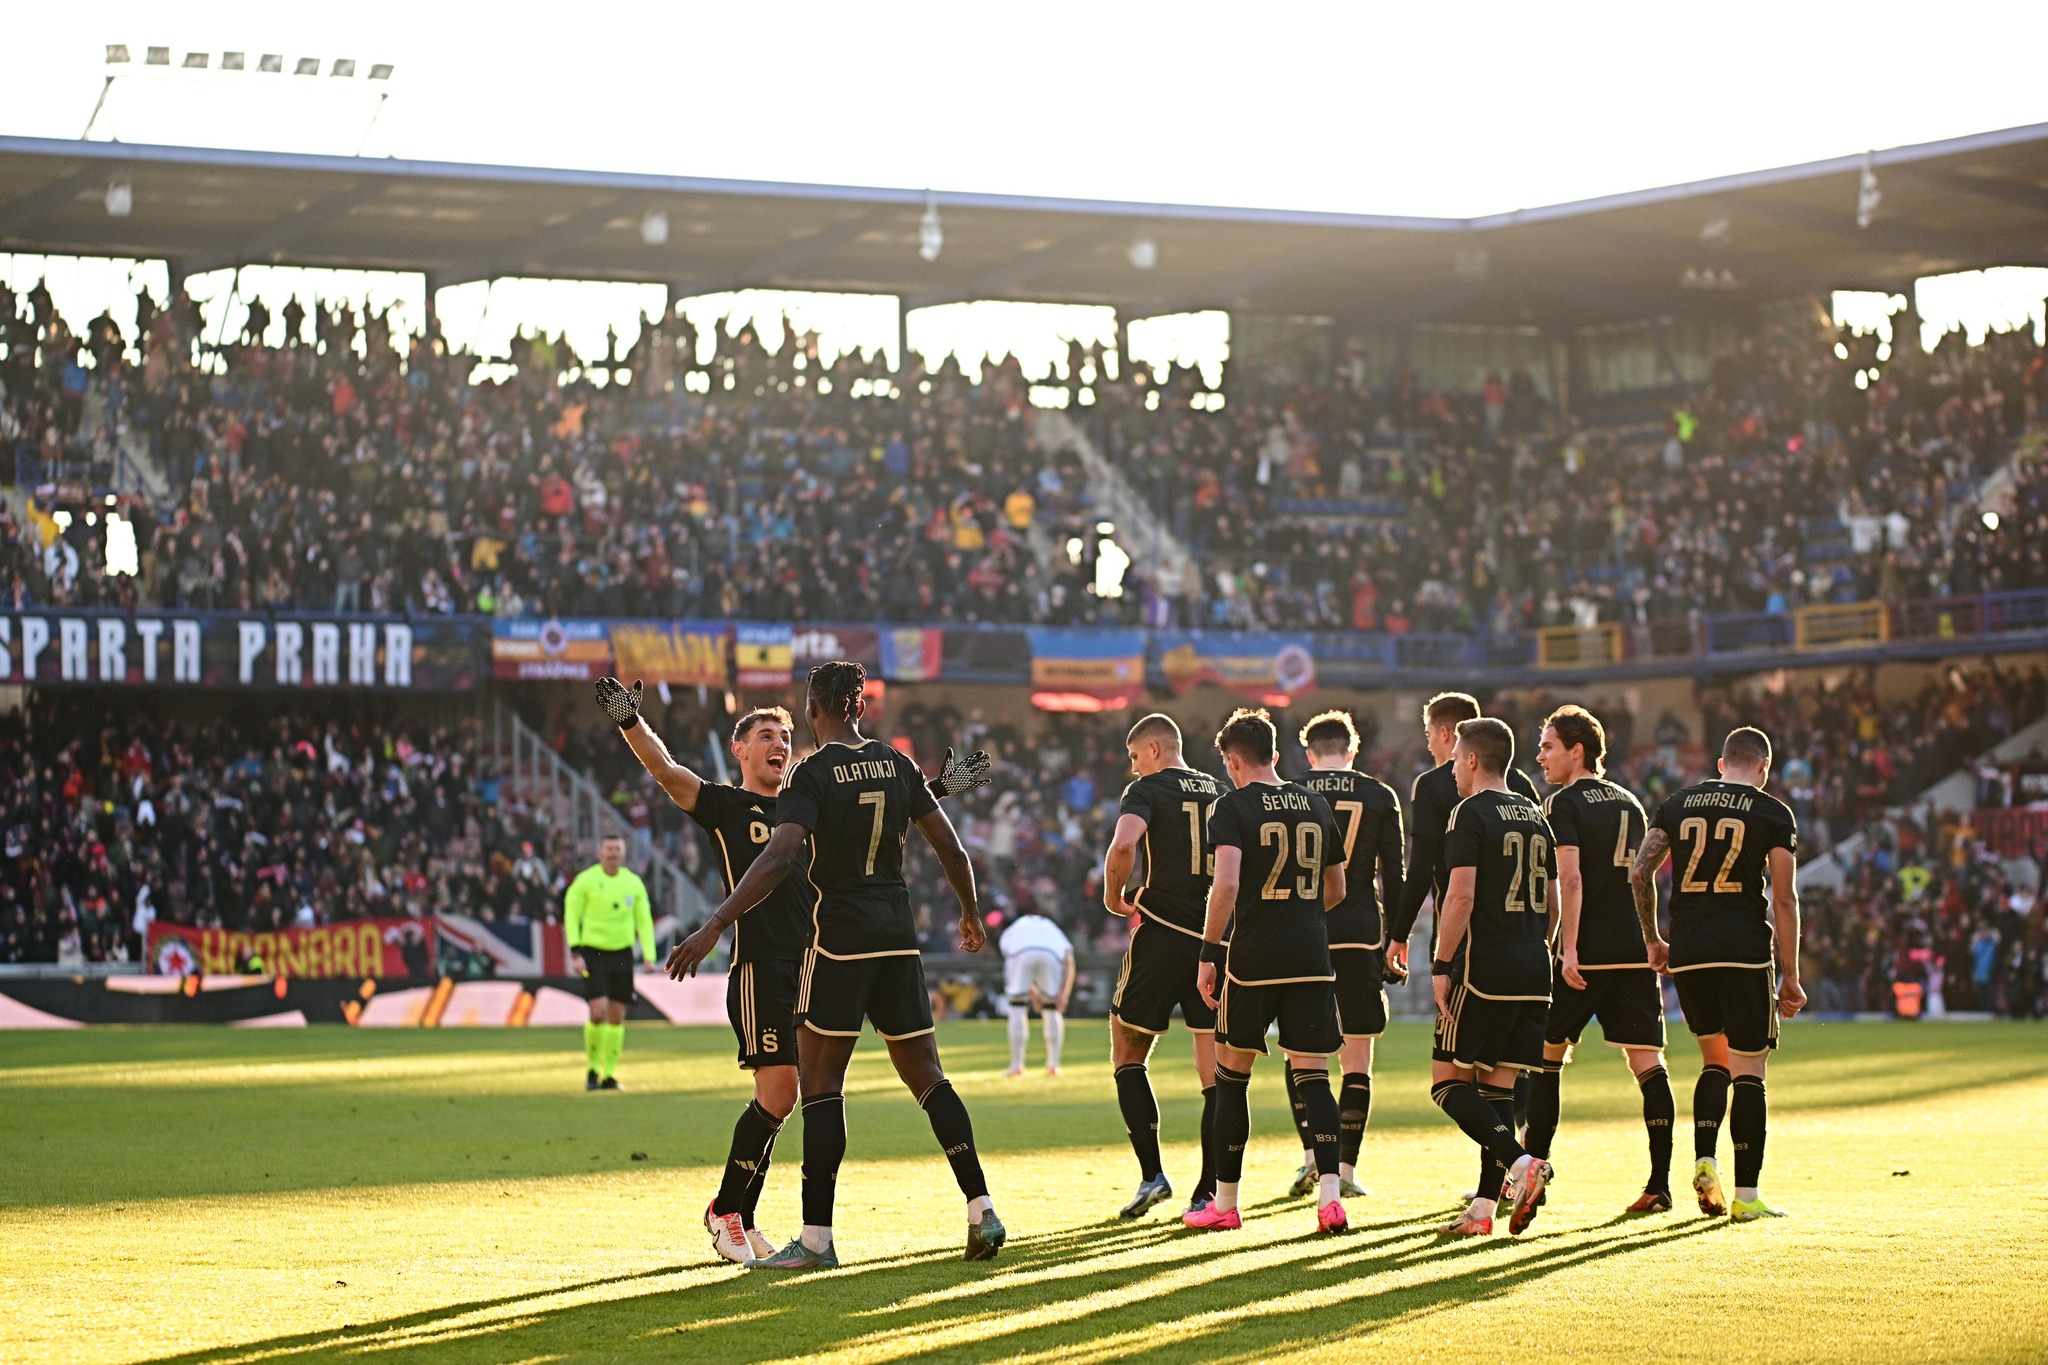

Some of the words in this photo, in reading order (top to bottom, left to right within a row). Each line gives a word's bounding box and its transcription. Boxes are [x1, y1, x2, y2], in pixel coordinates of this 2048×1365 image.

[238, 620, 412, 687] PRAHA
[833, 760, 897, 783] OLATUNJI
[1262, 792, 1311, 811] ŠEVČÍK
[1683, 792, 1753, 811] HARASLÍN
[859, 791, 885, 876] 7
[1182, 801, 1215, 877] 1
[1260, 822, 1322, 900] 29
[1613, 809, 1637, 884] 4
[1680, 817, 1746, 893] 22
[1315, 1133, 1338, 1142] 1893
